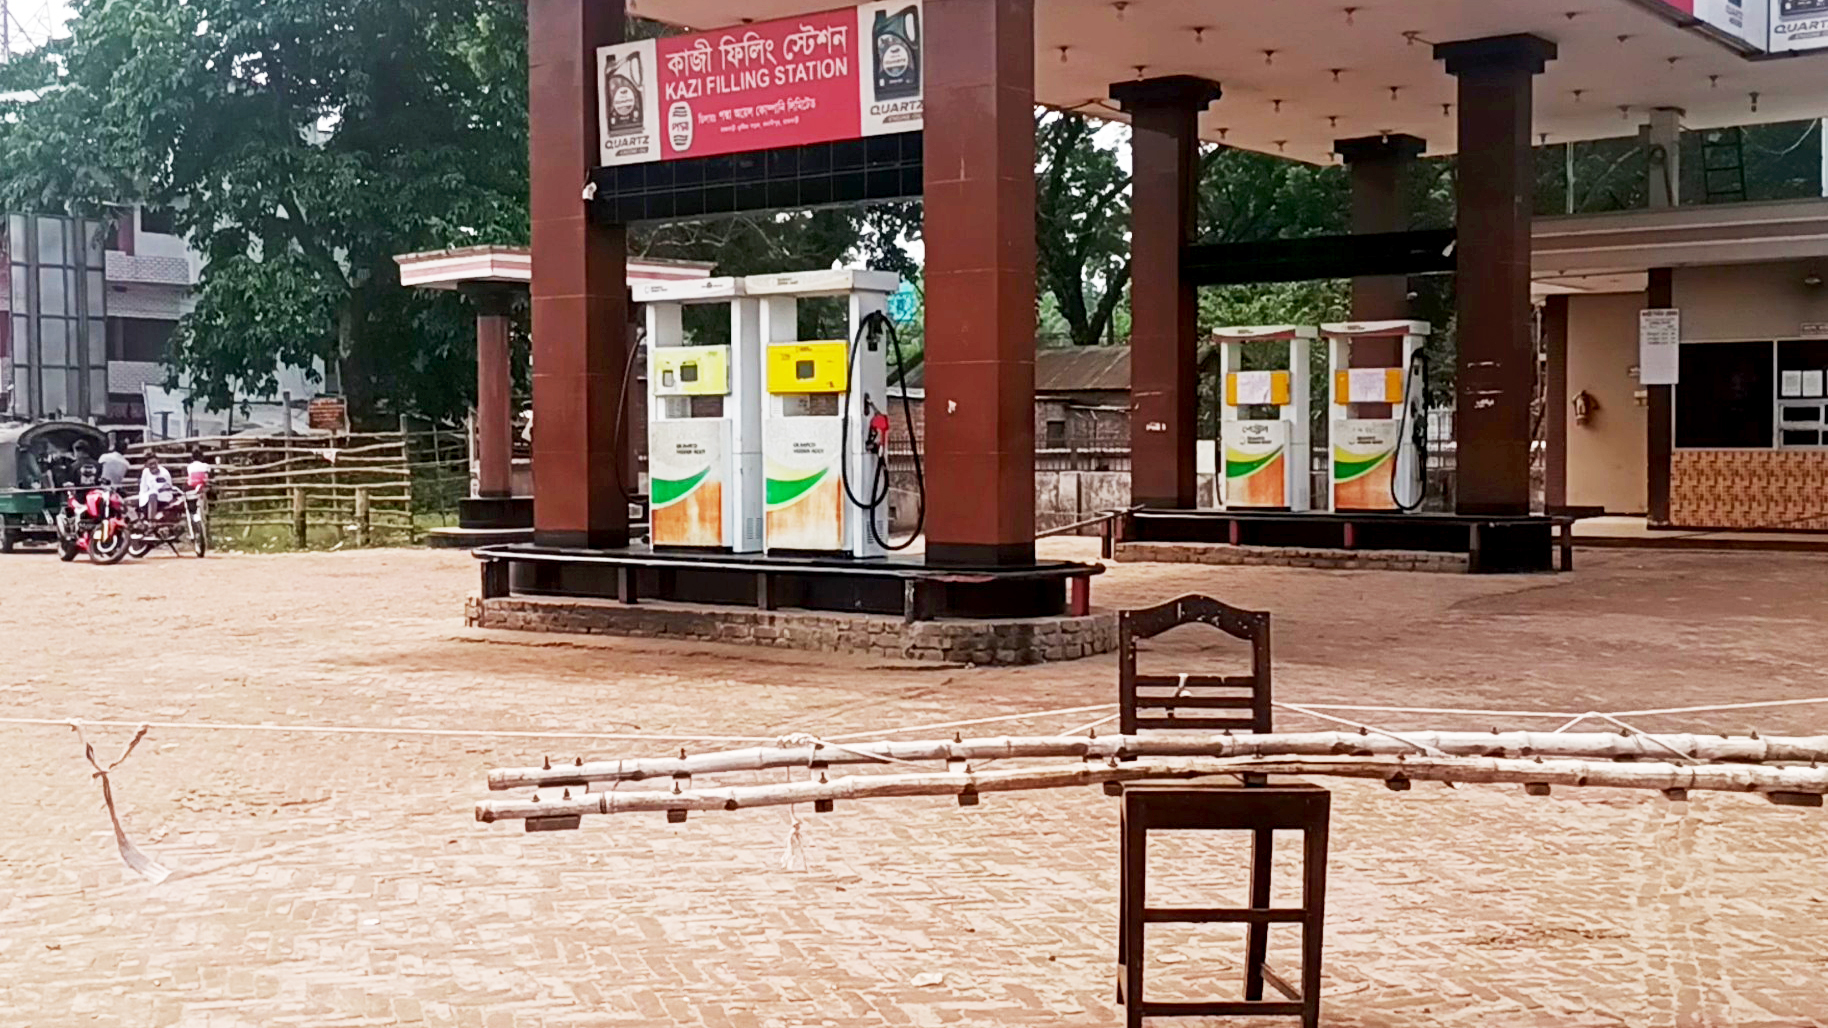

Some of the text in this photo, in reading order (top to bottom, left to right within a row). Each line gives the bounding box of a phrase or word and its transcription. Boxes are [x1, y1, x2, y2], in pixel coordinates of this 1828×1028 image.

[1774, 21, 1828, 34] QUART
[665, 22, 848, 77] কাজী ফিলিং স্টেশন
[665, 78, 702, 100] KAZI
[706, 68, 770, 95] FILLING
[774, 57, 848, 85] STATION
[870, 101, 924, 116] QUARTZ
[604, 135, 650, 150] QUARTZ
